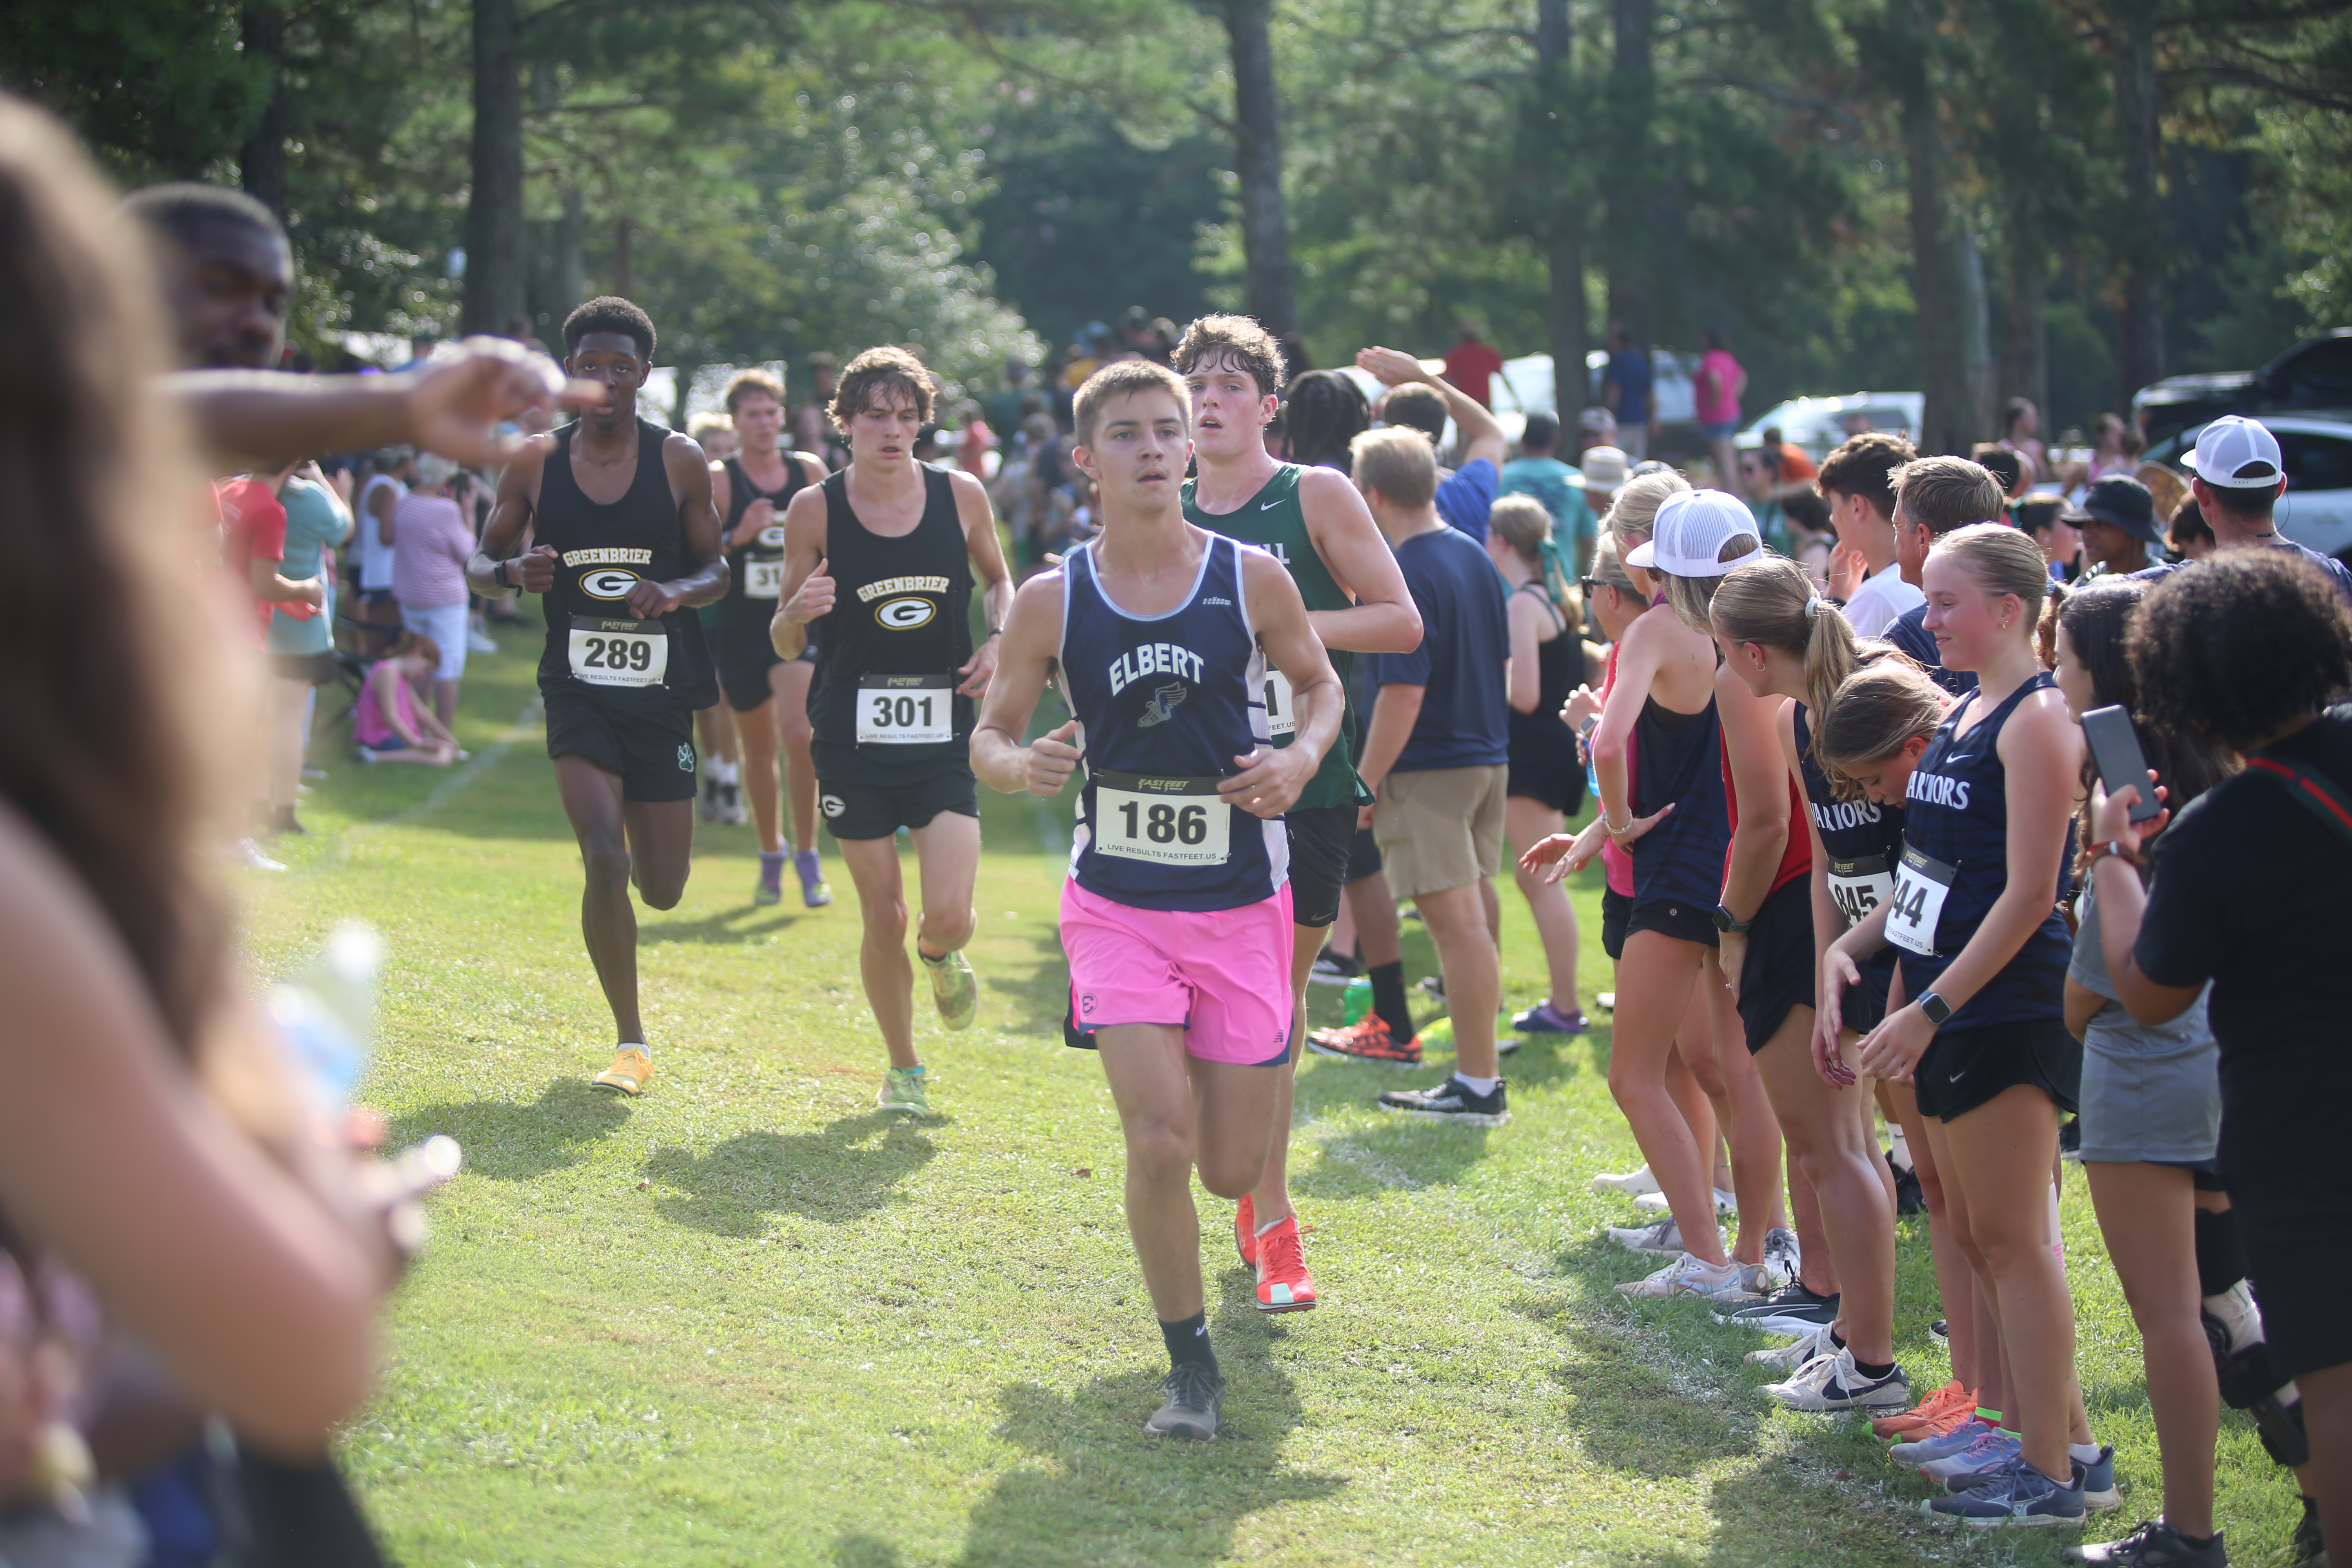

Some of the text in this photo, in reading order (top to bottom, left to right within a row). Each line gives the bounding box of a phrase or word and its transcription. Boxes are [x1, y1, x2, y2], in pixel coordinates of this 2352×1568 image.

[562, 548, 652, 567] GREENBRIER
[857, 575, 950, 603] GREENBRIER
[880, 600, 932, 627] G
[584, 637, 651, 671] 289
[1109, 643, 1204, 696] ELBERT
[873, 696, 932, 727] 301
[1119, 800, 1207, 845] 186
[1107, 844, 1124, 852] LIVE
[1126, 845, 1161, 858] RESULTS
[1835, 884, 1879, 923] 845
